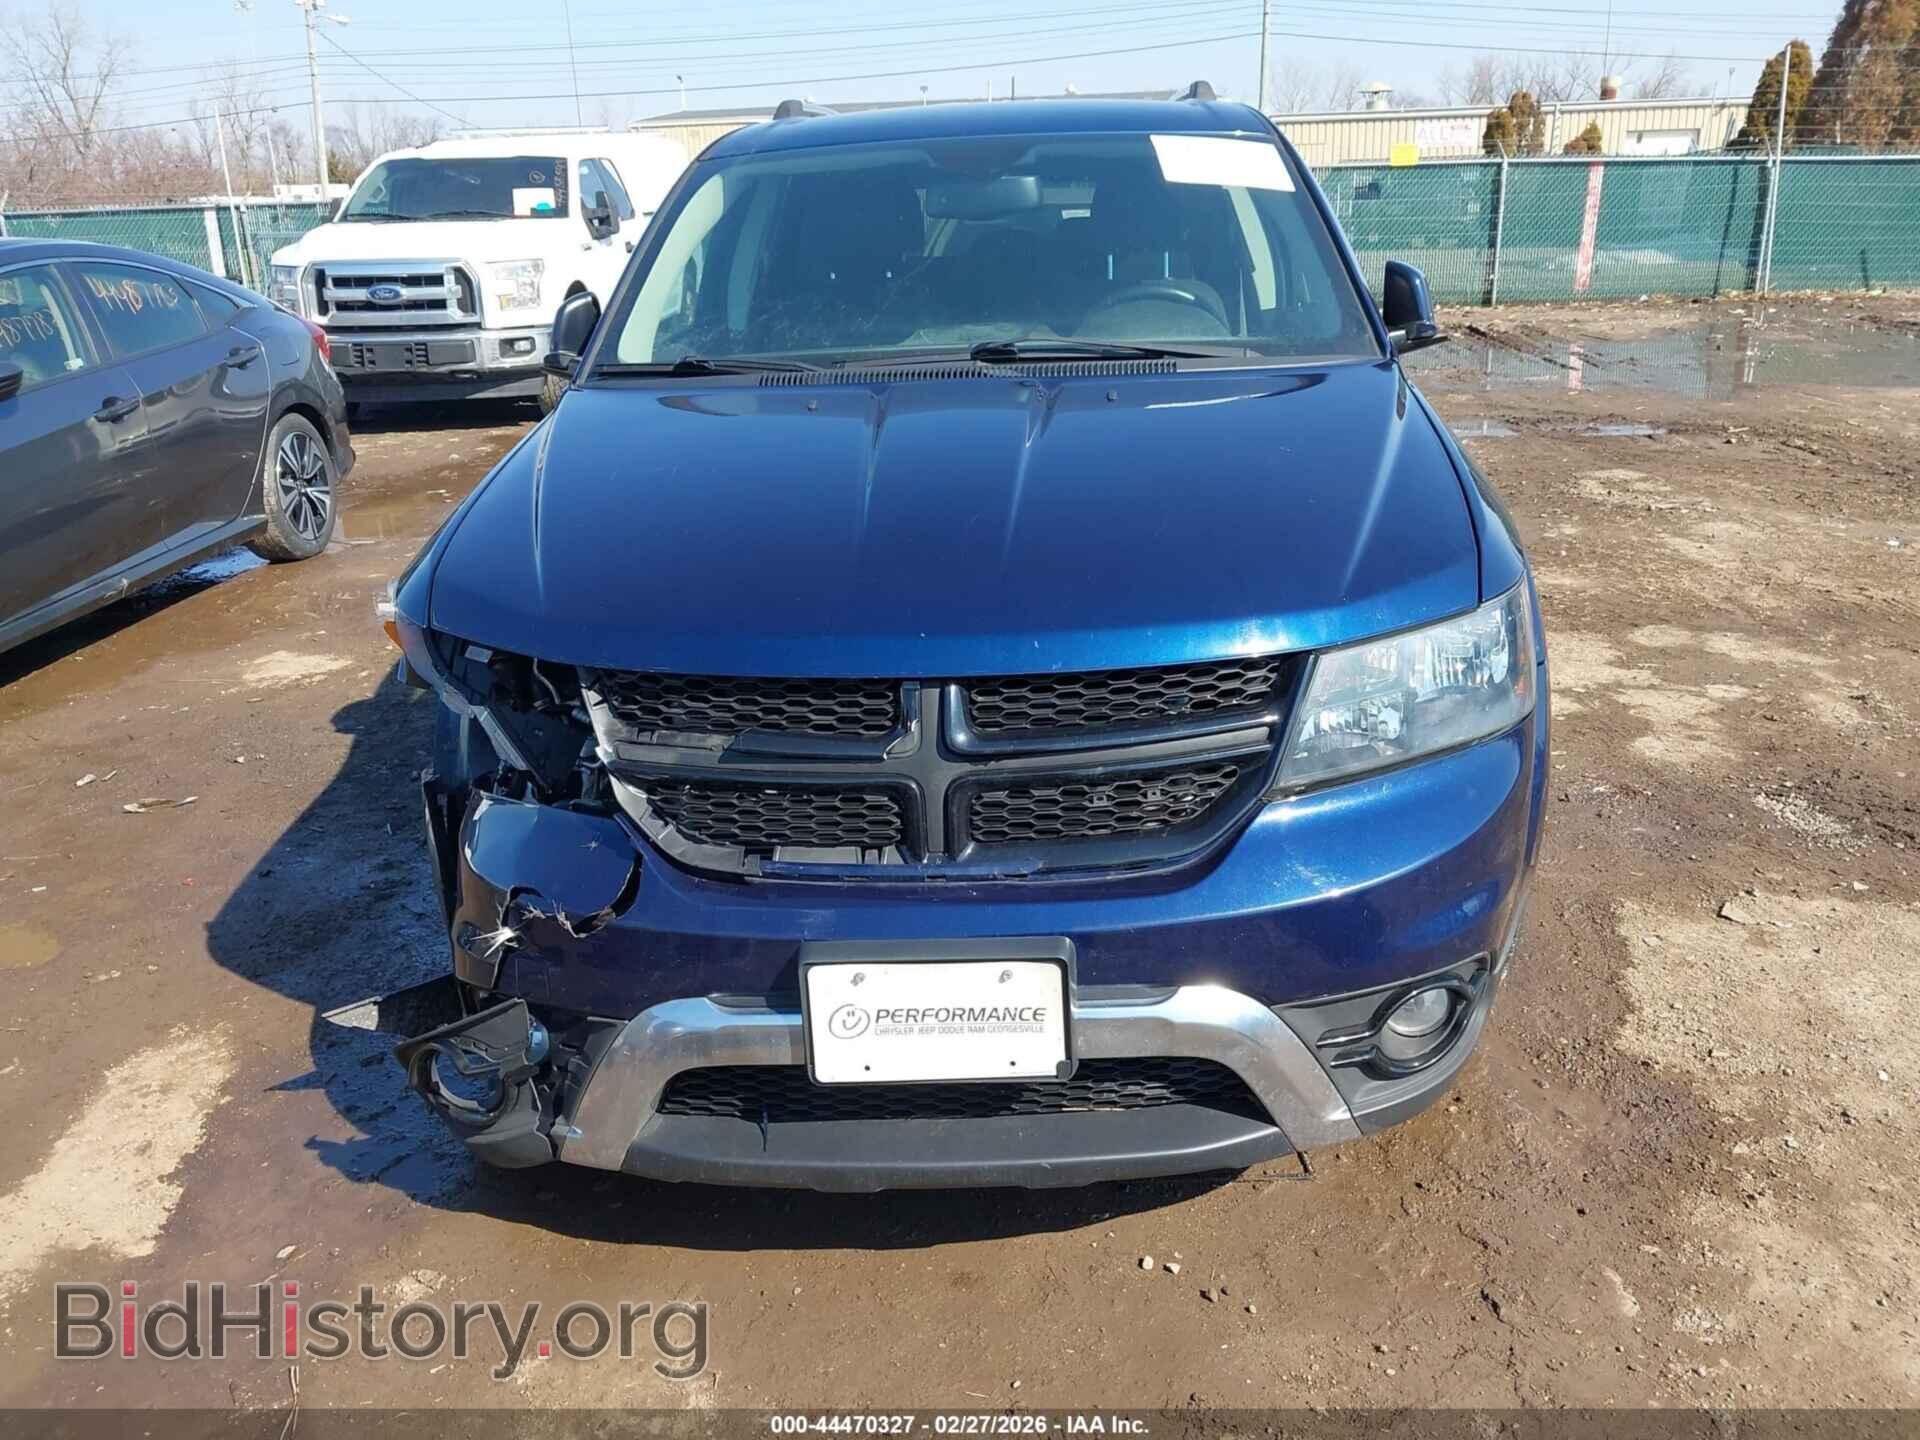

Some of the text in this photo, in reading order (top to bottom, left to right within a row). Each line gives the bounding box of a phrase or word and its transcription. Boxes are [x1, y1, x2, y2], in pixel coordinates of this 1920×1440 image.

[875, 1007, 1047, 1024] PERFORMANCE
[874, 1025, 914, 1036] CHRYSLER
[918, 1025, 936, 1035] JEEP
[967, 1024, 985, 1034] RAM
